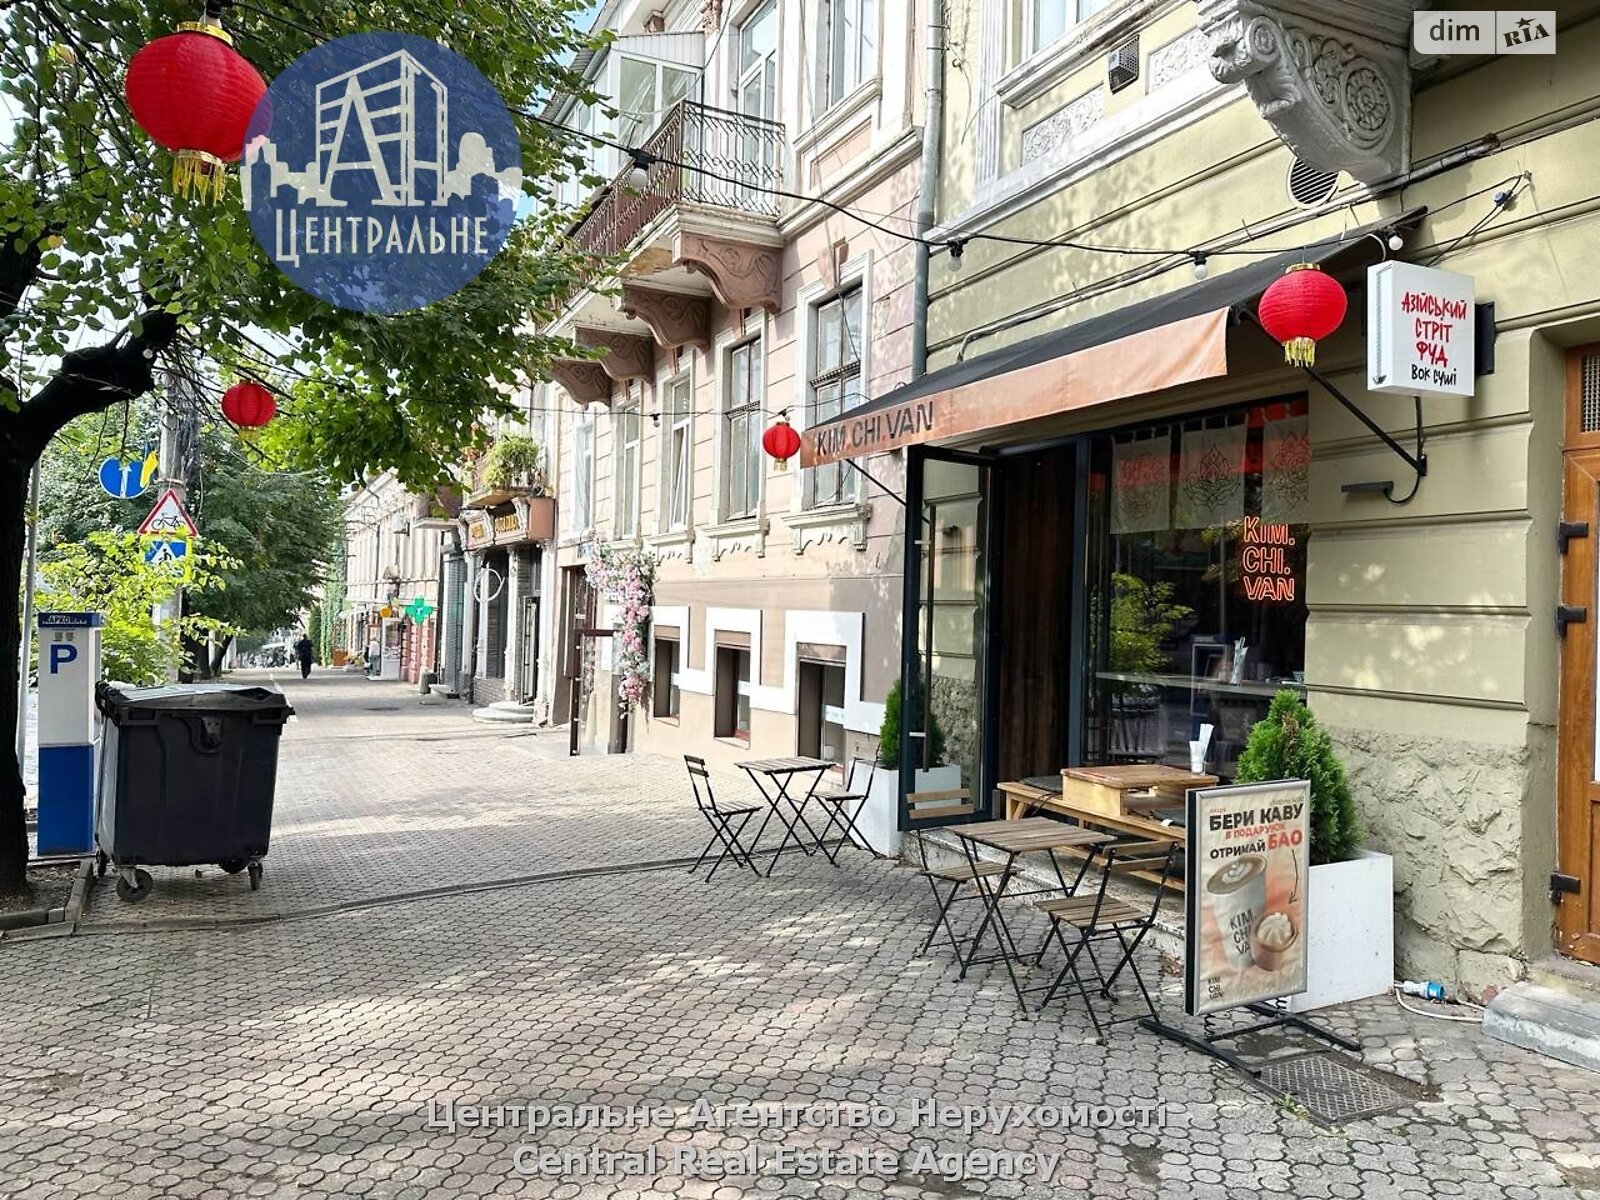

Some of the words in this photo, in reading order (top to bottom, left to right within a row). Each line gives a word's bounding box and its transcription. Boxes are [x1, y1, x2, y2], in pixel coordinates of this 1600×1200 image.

[1401, 291, 1467, 320] АЗІЙСЬКИЙ
[1415, 317, 1453, 342] СТРІТ
[1416, 341, 1448, 368] ФУД
[1243, 515, 1296, 546] KIM.
[1242, 545, 1291, 575] CHI.
[1243, 575, 1295, 601] VAN
[50, 644, 78, 674] P
[1209, 809, 1255, 831] БЕРИ
[1260, 803, 1304, 824] КАВУ
[1209, 839, 1266, 860] ОТРИМАЙ
[1267, 829, 1303, 850] БАО
